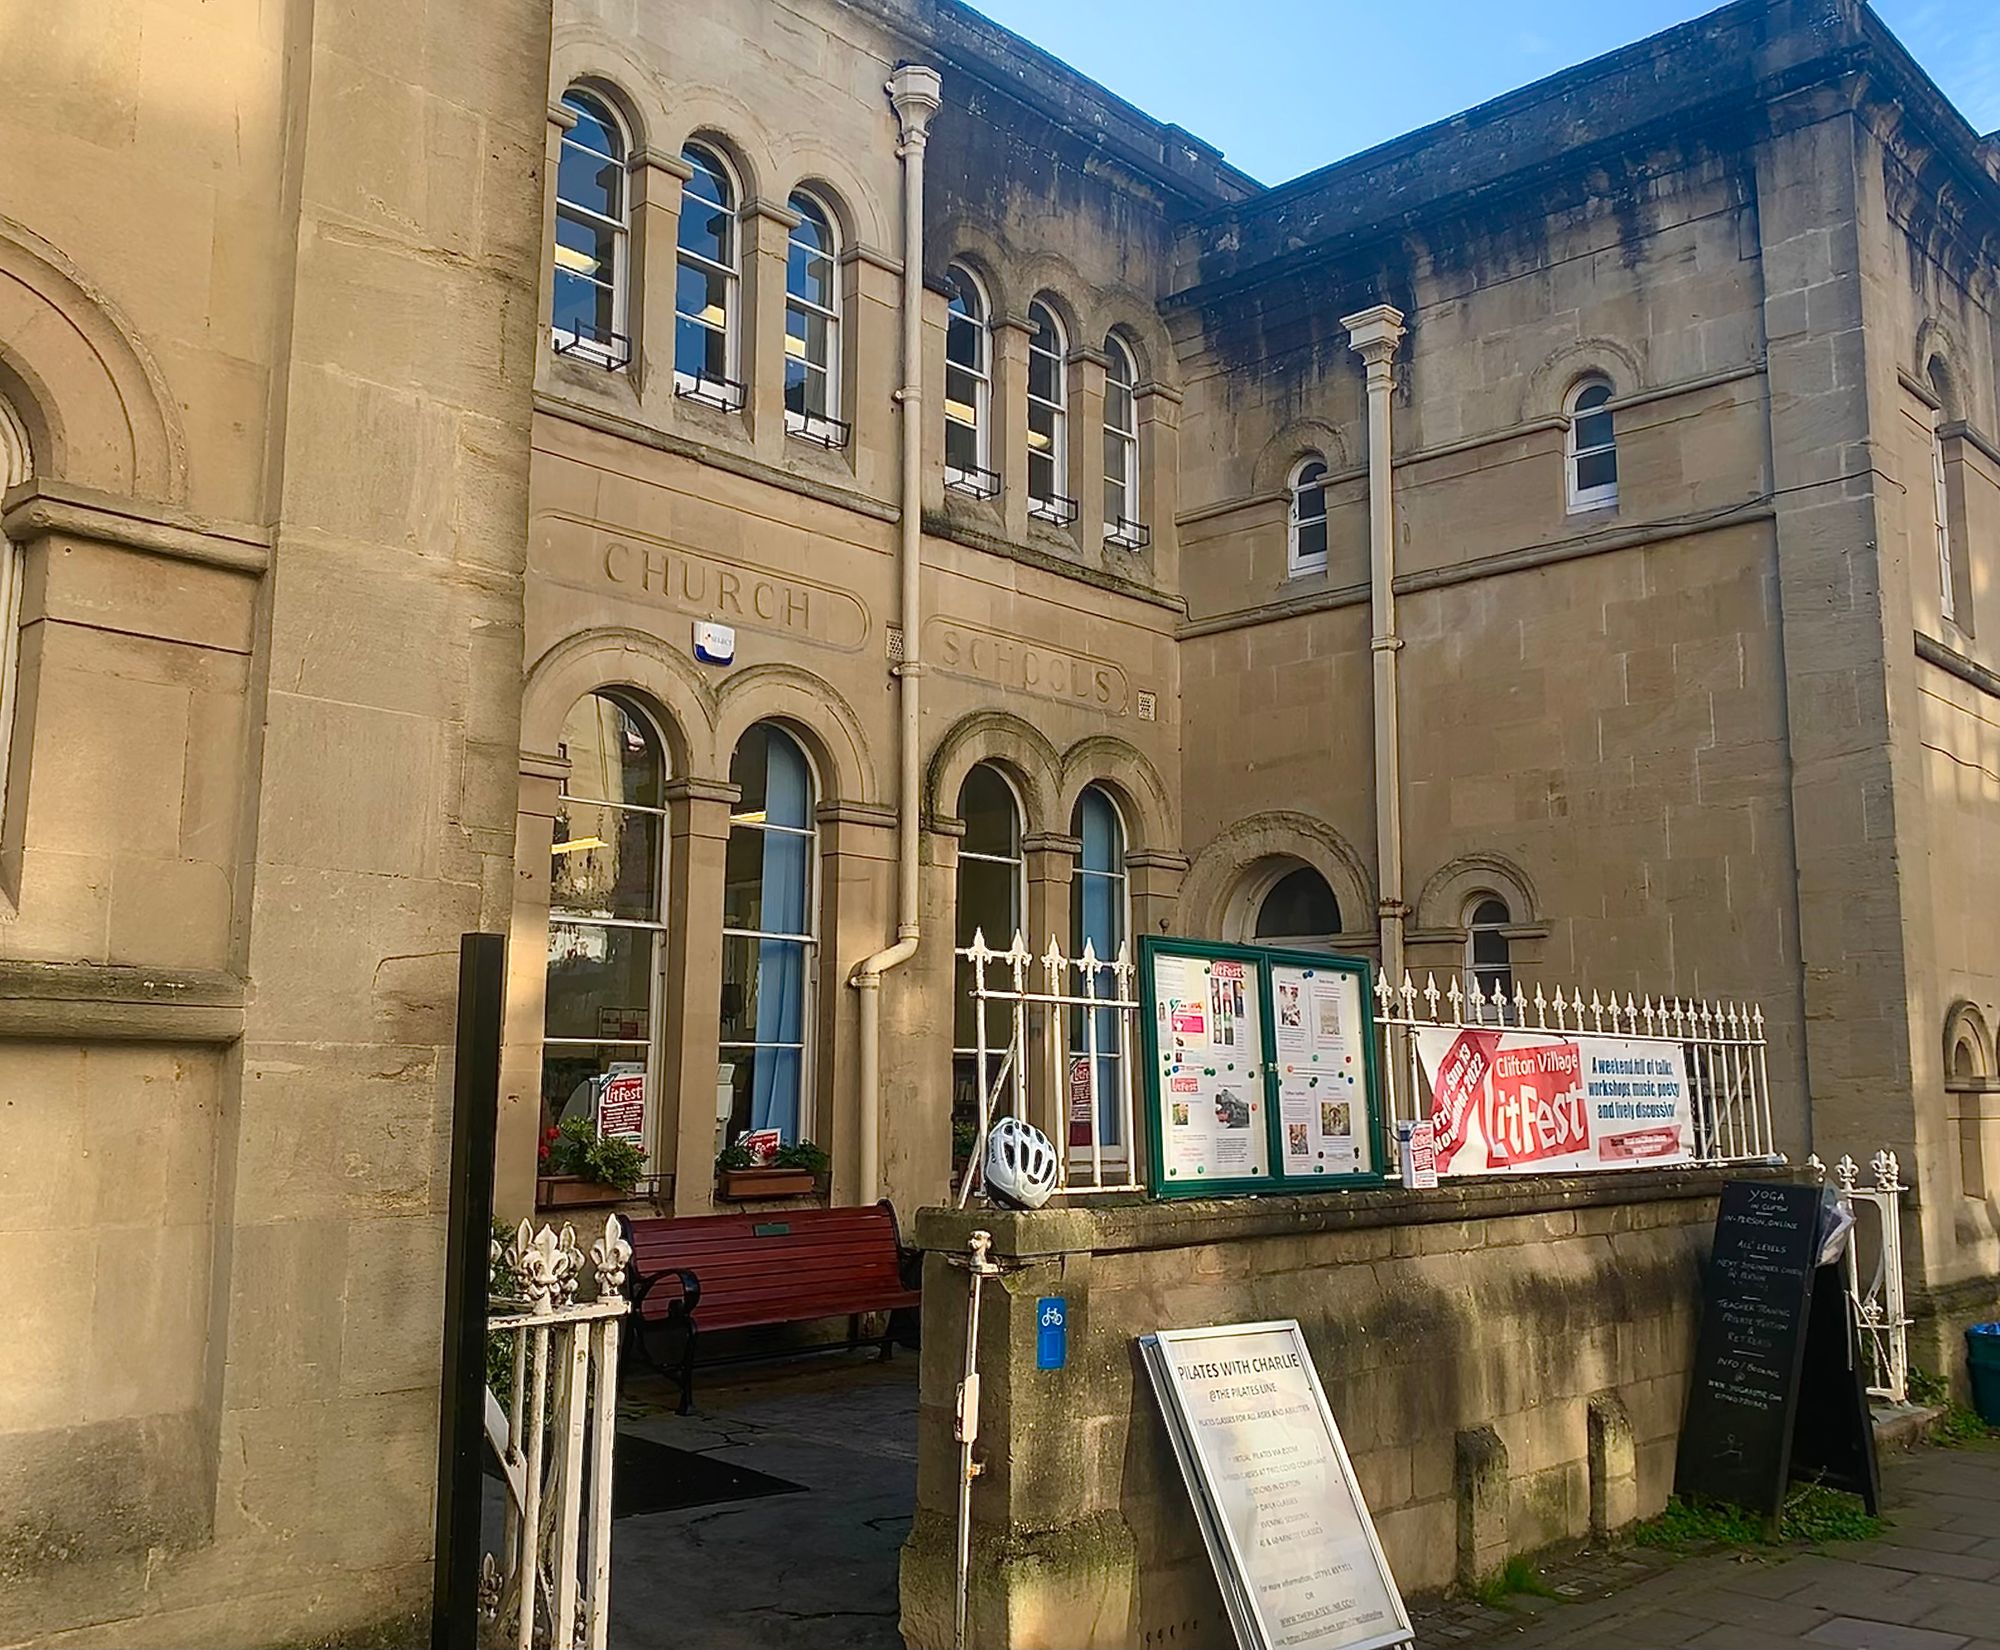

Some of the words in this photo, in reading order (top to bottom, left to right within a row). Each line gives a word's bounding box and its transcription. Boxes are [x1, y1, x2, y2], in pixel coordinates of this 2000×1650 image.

[603, 542, 810, 630] CHURCH
[942, 631, 1111, 703] SCHOOLS
[1446, 1060, 1465, 1093] Sun
[1459, 1042, 1472, 1066] 13
[1464, 1052, 1485, 1094] 2022
[1496, 1055, 1536, 1078] Clifton
[1537, 1051, 1579, 1075] Village
[1592, 1056, 1597, 1074] A
[1598, 1058, 1633, 1075] weekend
[606, 1086, 643, 1103] LitFest
[1483, 1064, 1585, 1158] LitFest
[1597, 1102, 1615, 1118] and
[1748, 1189, 1785, 1202] YOGA
[1757, 1243, 1787, 1253] LEVELS
[1178, 1363, 1220, 1381] PILATES
[1220, 1360, 1251, 1377] WITH
[1252, 1353, 1300, 1373] CHARLIE
[1209, 1387, 1231, 1402] @THE
[1232, 1384, 1261, 1400] PILATES
[1261, 1382, 1279, 1395] LINE
[1272, 1409, 1285, 1418] AND
